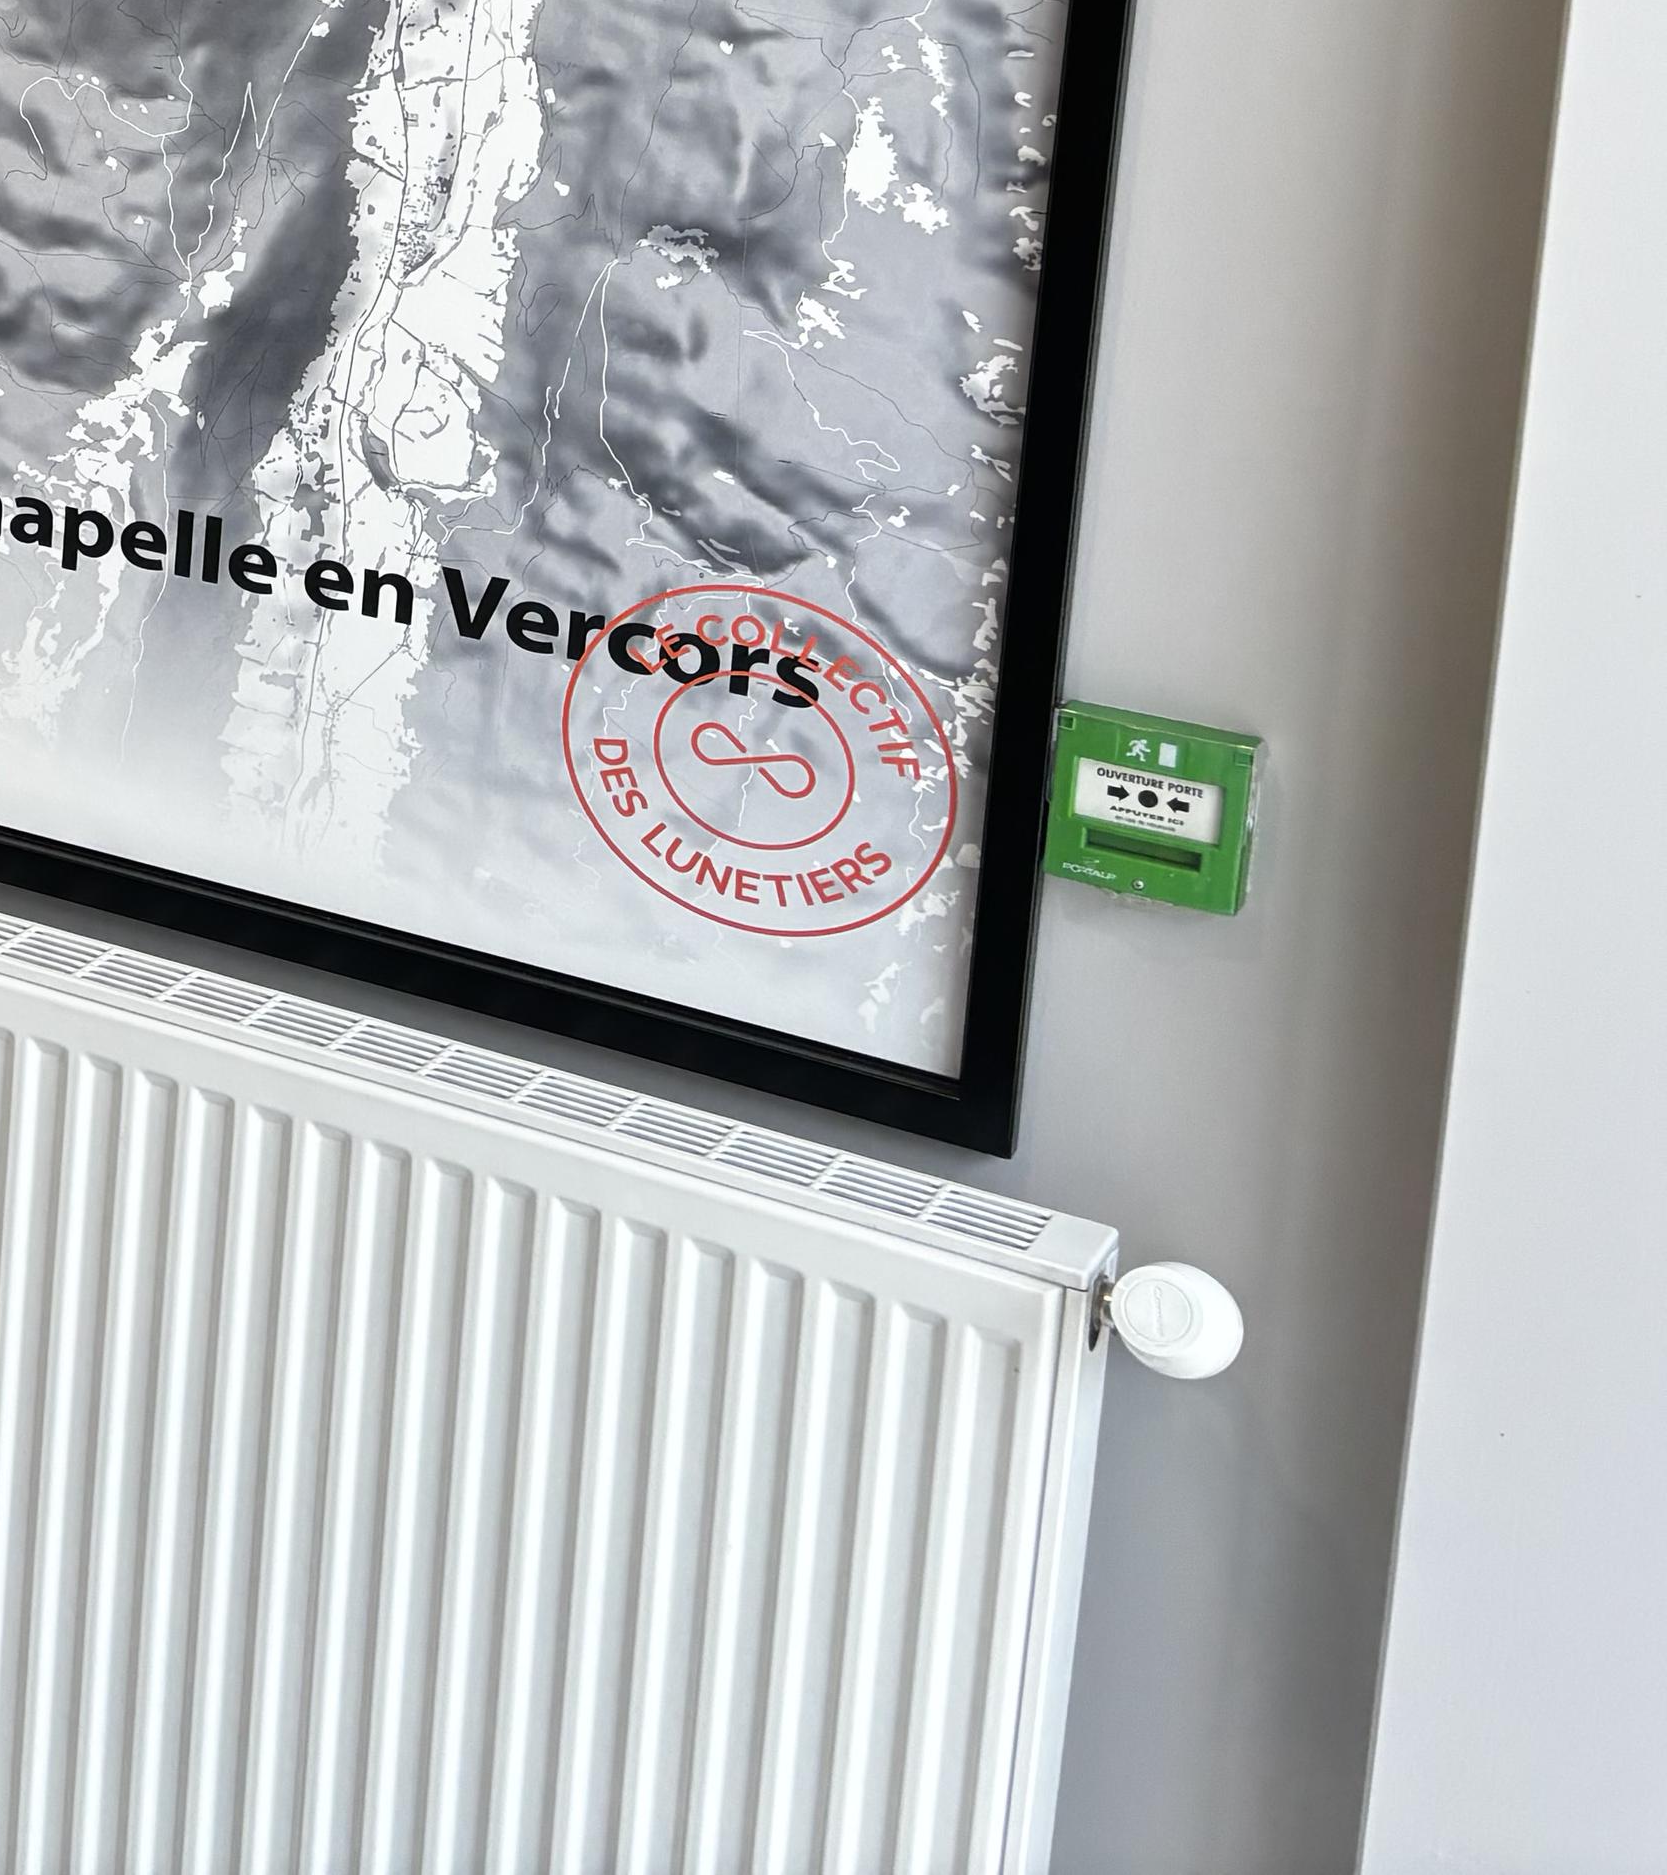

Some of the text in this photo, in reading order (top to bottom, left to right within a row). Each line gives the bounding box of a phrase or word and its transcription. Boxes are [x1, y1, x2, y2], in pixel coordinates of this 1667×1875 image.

[303, 555, 414, 625] en
[443, 566, 821, 710] Vercors
[630, 614, 922, 781] LE COLLECTIF
[592, 737, 893, 908] DES LUNETIERS
[1096, 766, 1204, 799] OUVERTURE PORTE
[1109, 805, 1165, 822] APPUYER
[1167, 817, 1185, 827] ICI
